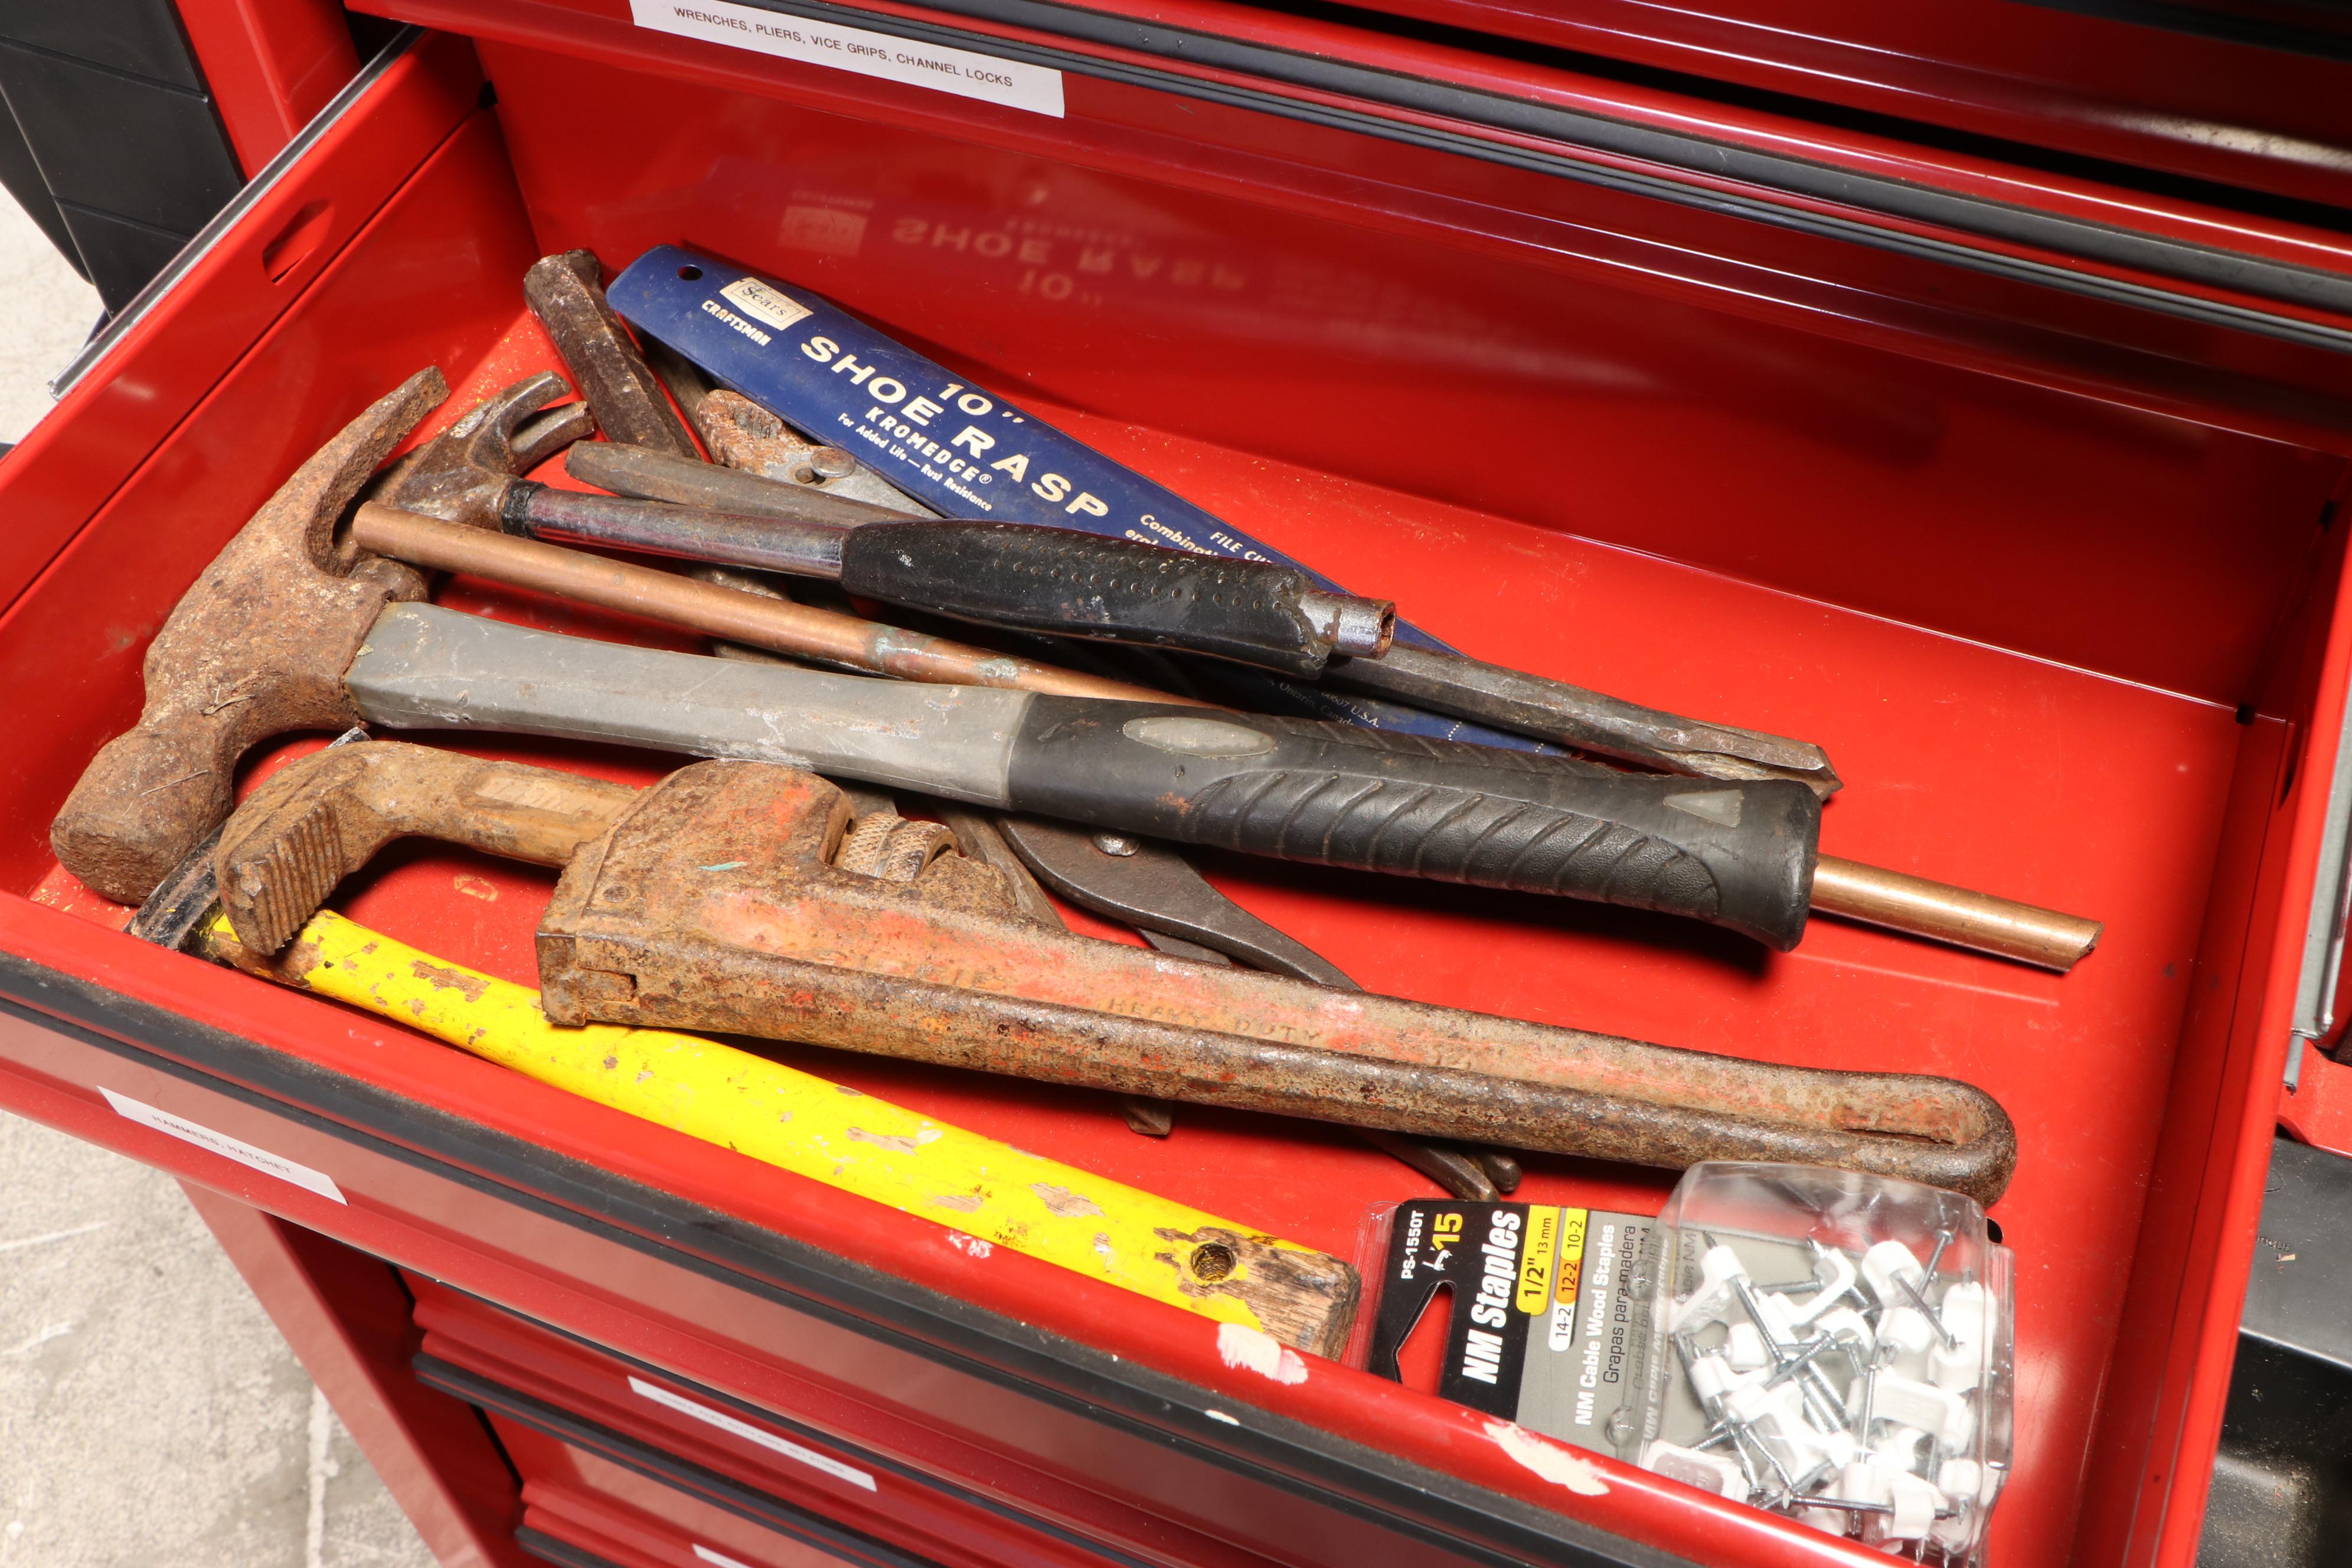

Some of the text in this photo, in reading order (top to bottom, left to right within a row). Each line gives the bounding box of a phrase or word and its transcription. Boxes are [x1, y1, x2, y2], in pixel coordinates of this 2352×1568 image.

[674, 6, 1013, 87] WRENCHES, PLIERS, VICE GRIPS, CHANNEL LOCKS
[701, 299, 772, 347] CRAFTSMAN
[742, 286, 787, 316] Sears
[801, 336, 1109, 517] SHOE RASP
[837, 413, 855, 427] For
[855, 424, 890, 449] Added
[888, 444, 907, 460] Life
[920, 463, 943, 482] Rust
[943, 477, 992, 511] Resistance
[1210, 531, 1243, 553] FILE
[1350, 704, 1380, 728] U.S.A.
[227, 1144, 292, 1174] HATCHET
[1401, 1210, 1425, 1279] PS-1550T
[1524, 1217, 1552, 1298] 1/2" 13 mm
[1567, 1220, 1583, 1250] 10-2
[1462, 1210, 1521, 1385] NM Staples
[1562, 1262, 1577, 1292] 12-2
[1603, 1225, 1636, 1384] Grapas para madera
[1556, 1307, 1572, 1338] 14-2
[1574, 1224, 1616, 1426] NM Cable Wood Staples
